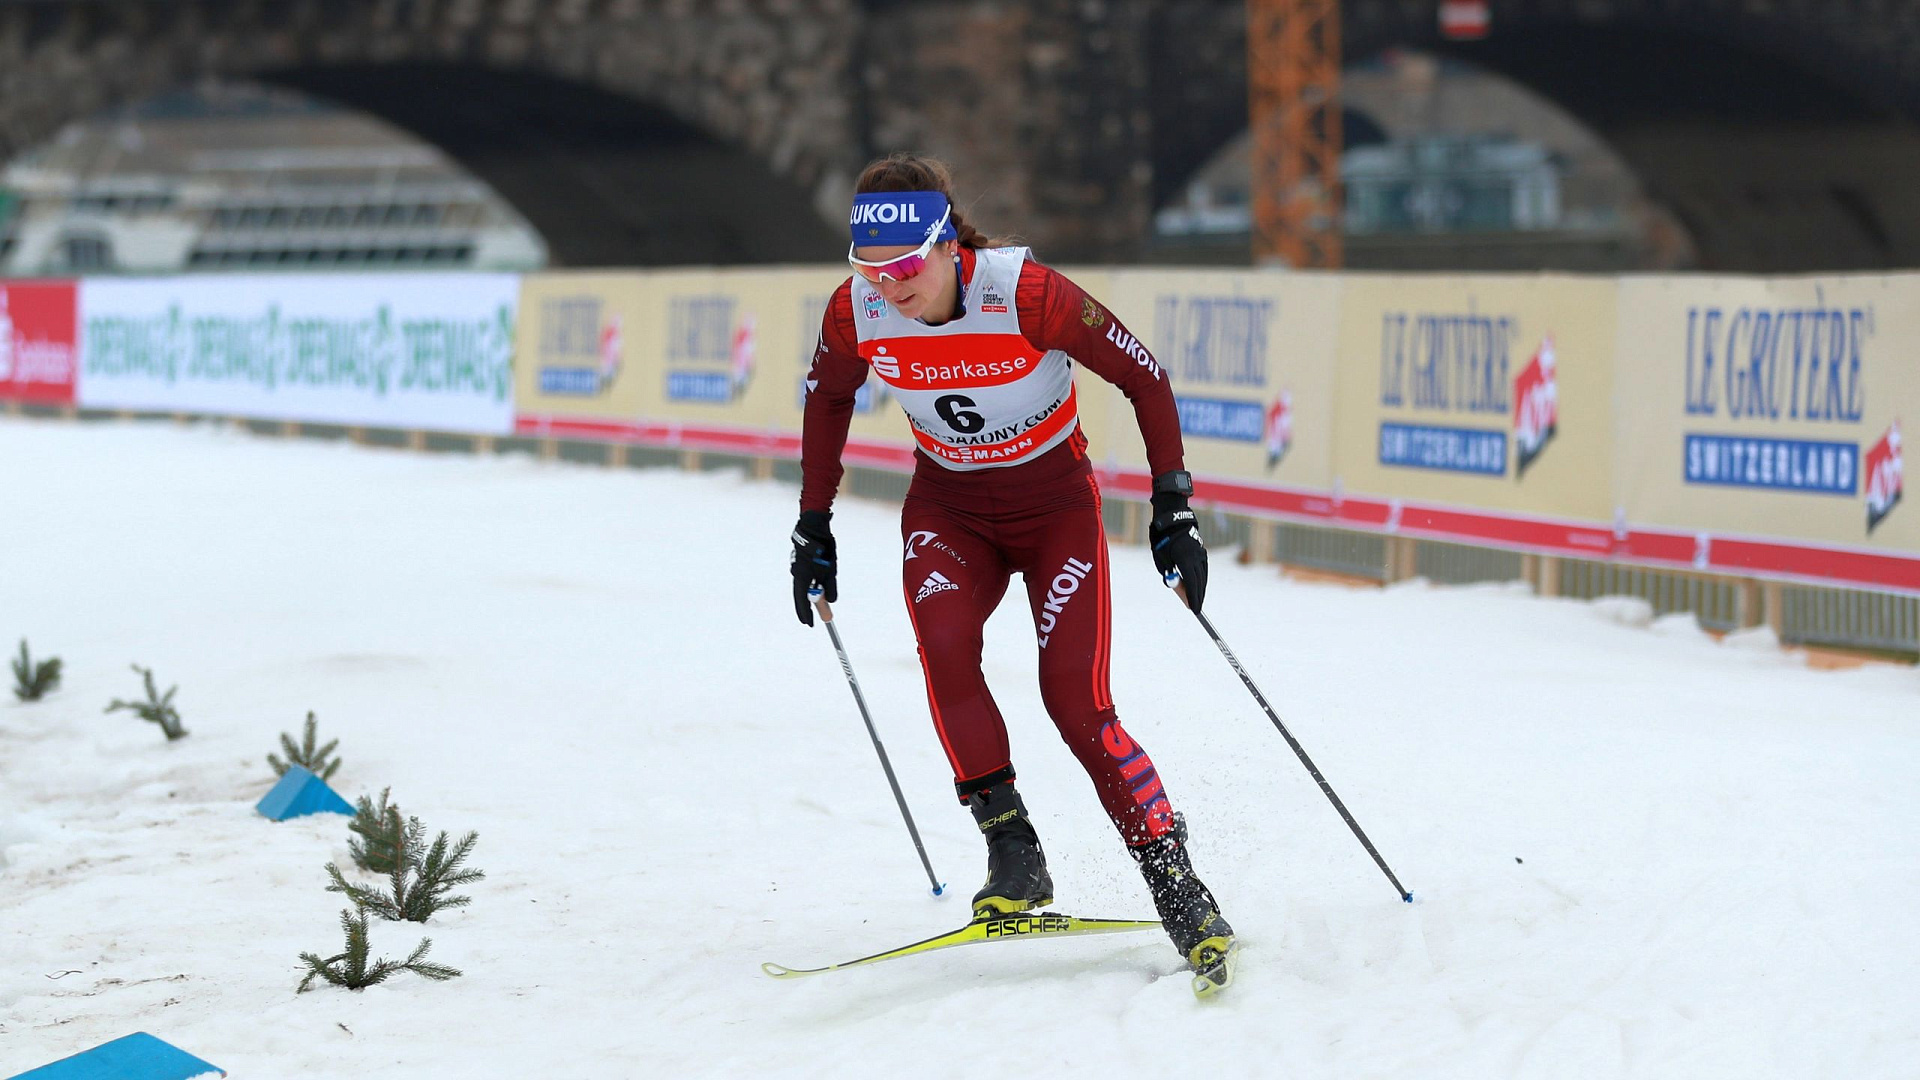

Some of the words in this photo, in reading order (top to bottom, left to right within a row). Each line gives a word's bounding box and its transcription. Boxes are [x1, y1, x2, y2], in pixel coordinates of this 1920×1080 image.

[850, 203, 920, 225] LUKOIL
[910, 356, 1027, 383] Sparkasse
[1105, 321, 1160, 381] LUKOIL
[1684, 308, 1722, 415] LE
[934, 394, 985, 434] 6
[1688, 439, 1850, 490] SWITZERLAND
[915, 583, 959, 604] adidas
[1039, 557, 1092, 648] LUKOIL
[986, 918, 1069, 938] FISCHER
